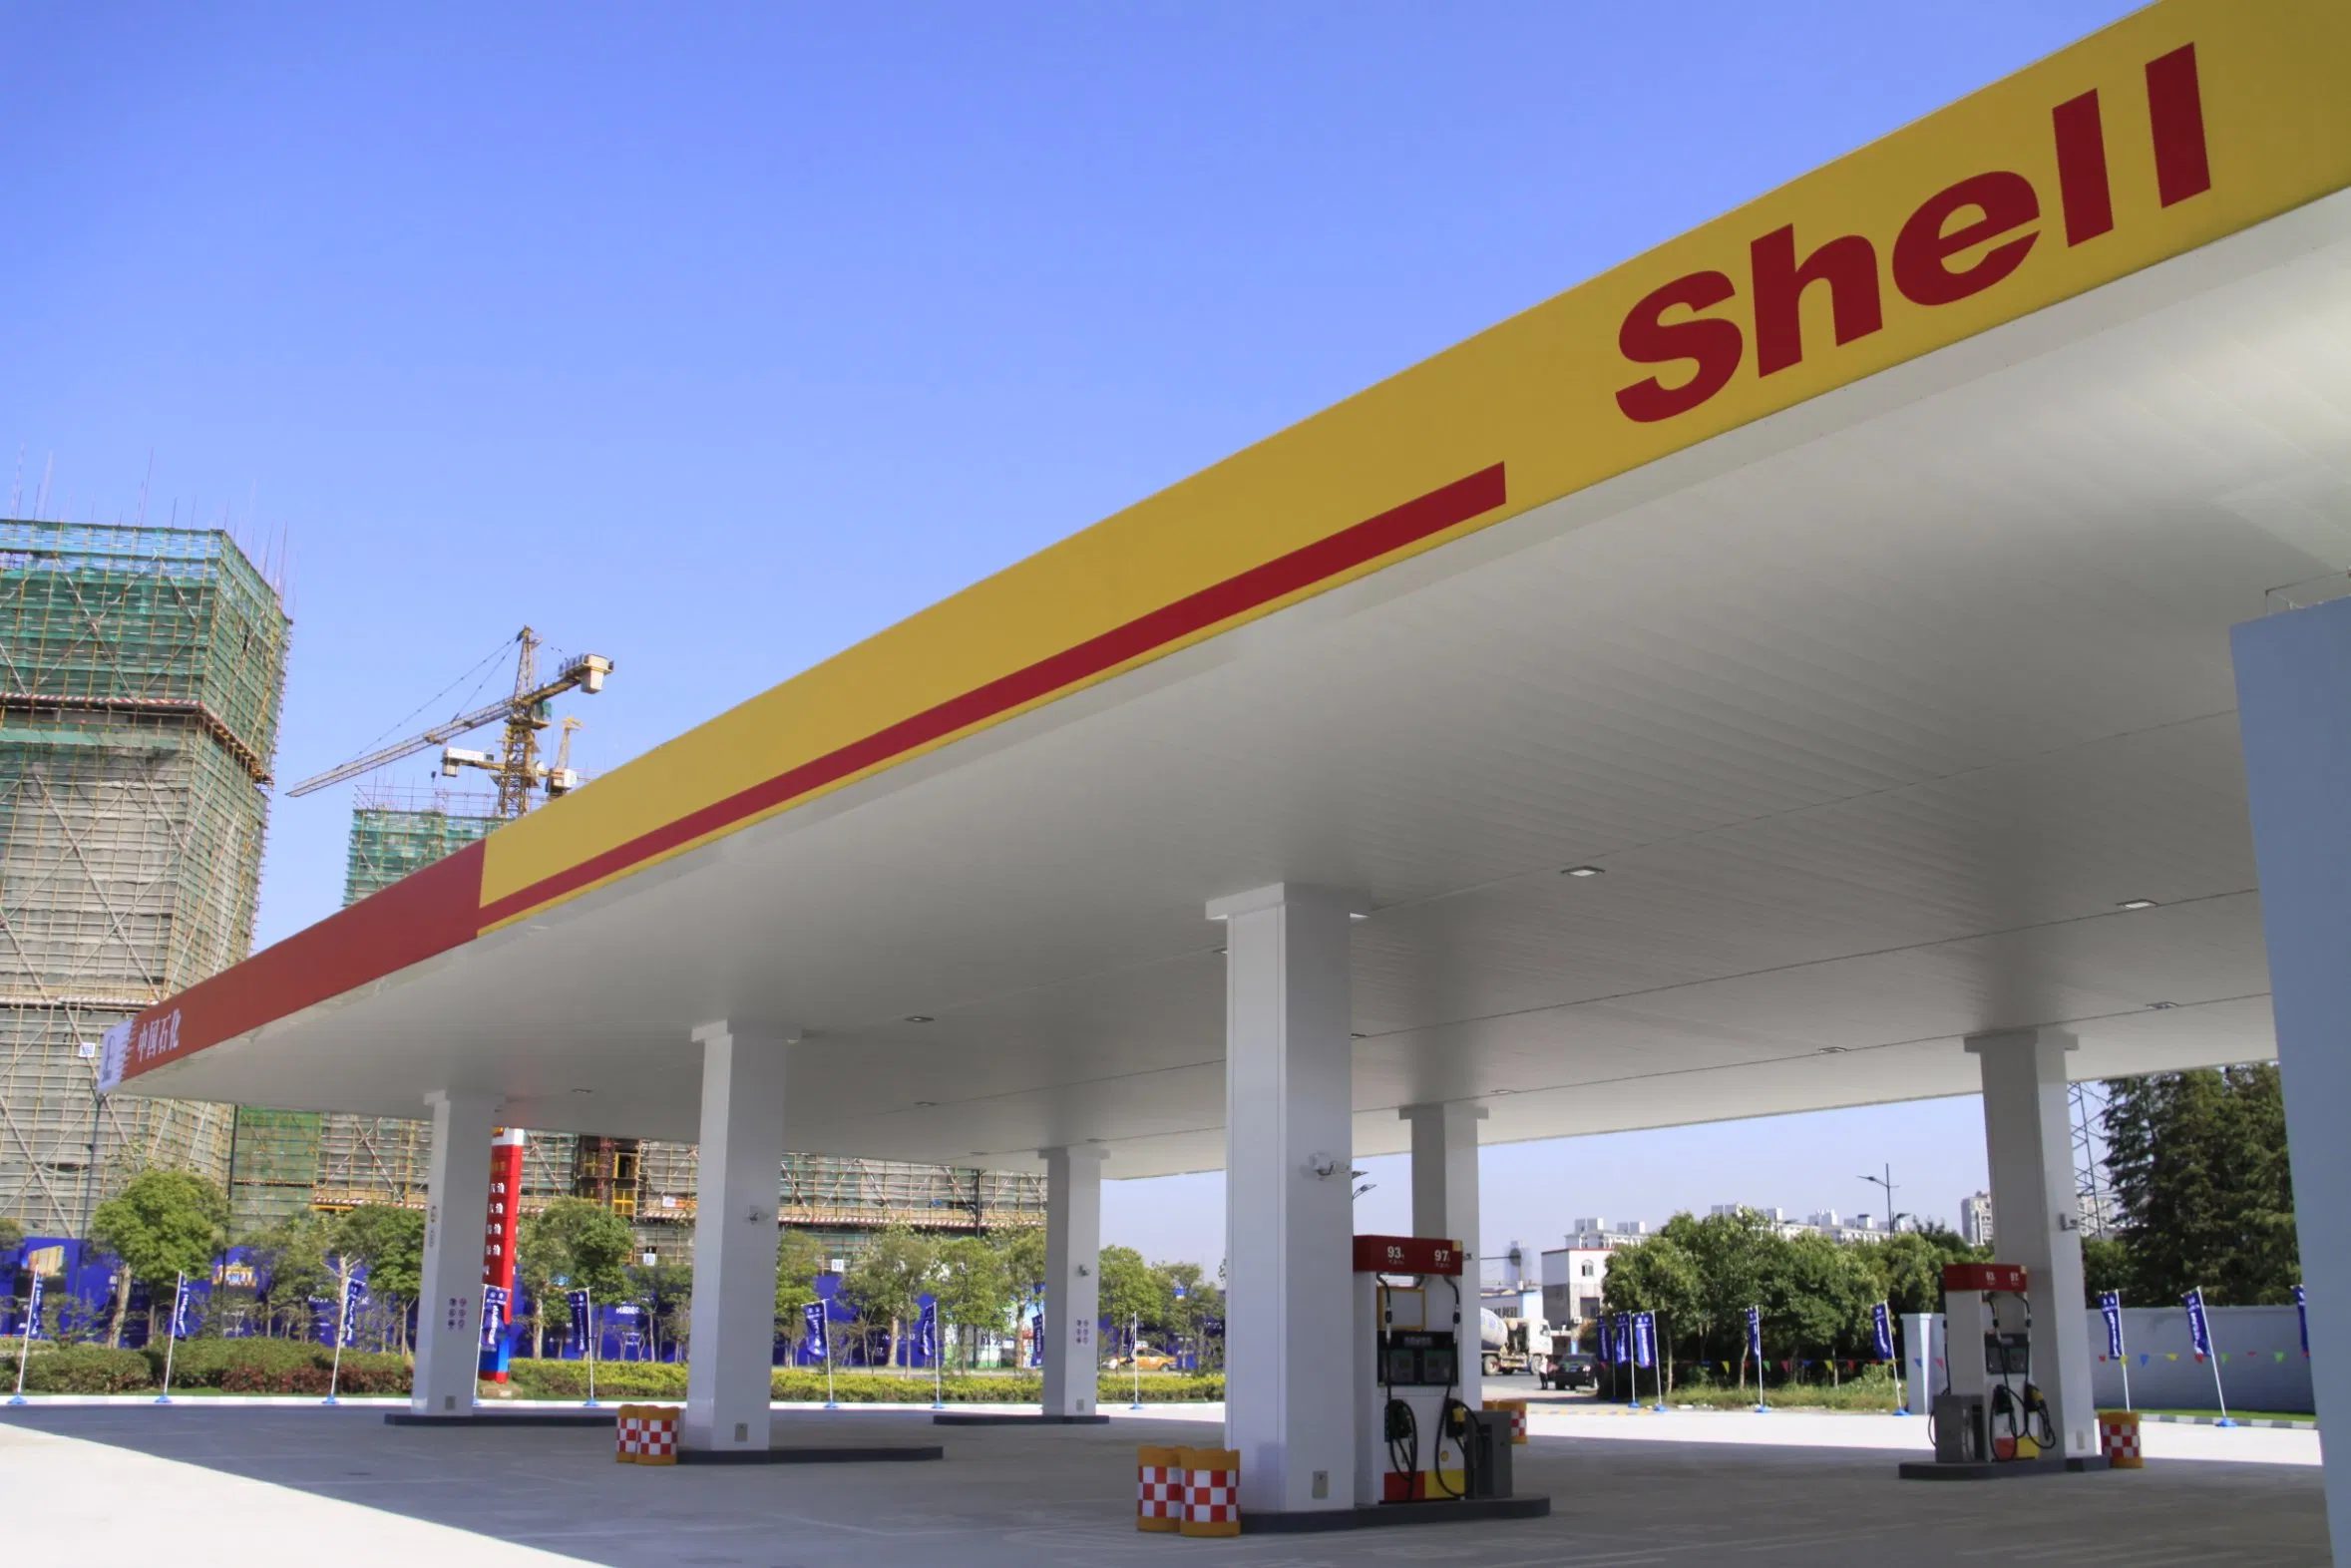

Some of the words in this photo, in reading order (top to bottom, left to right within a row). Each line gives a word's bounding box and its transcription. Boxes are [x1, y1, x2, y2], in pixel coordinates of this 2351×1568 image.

[1615, 41, 2211, 424] Shell
[137, 1008, 182, 1063] 中国石化
